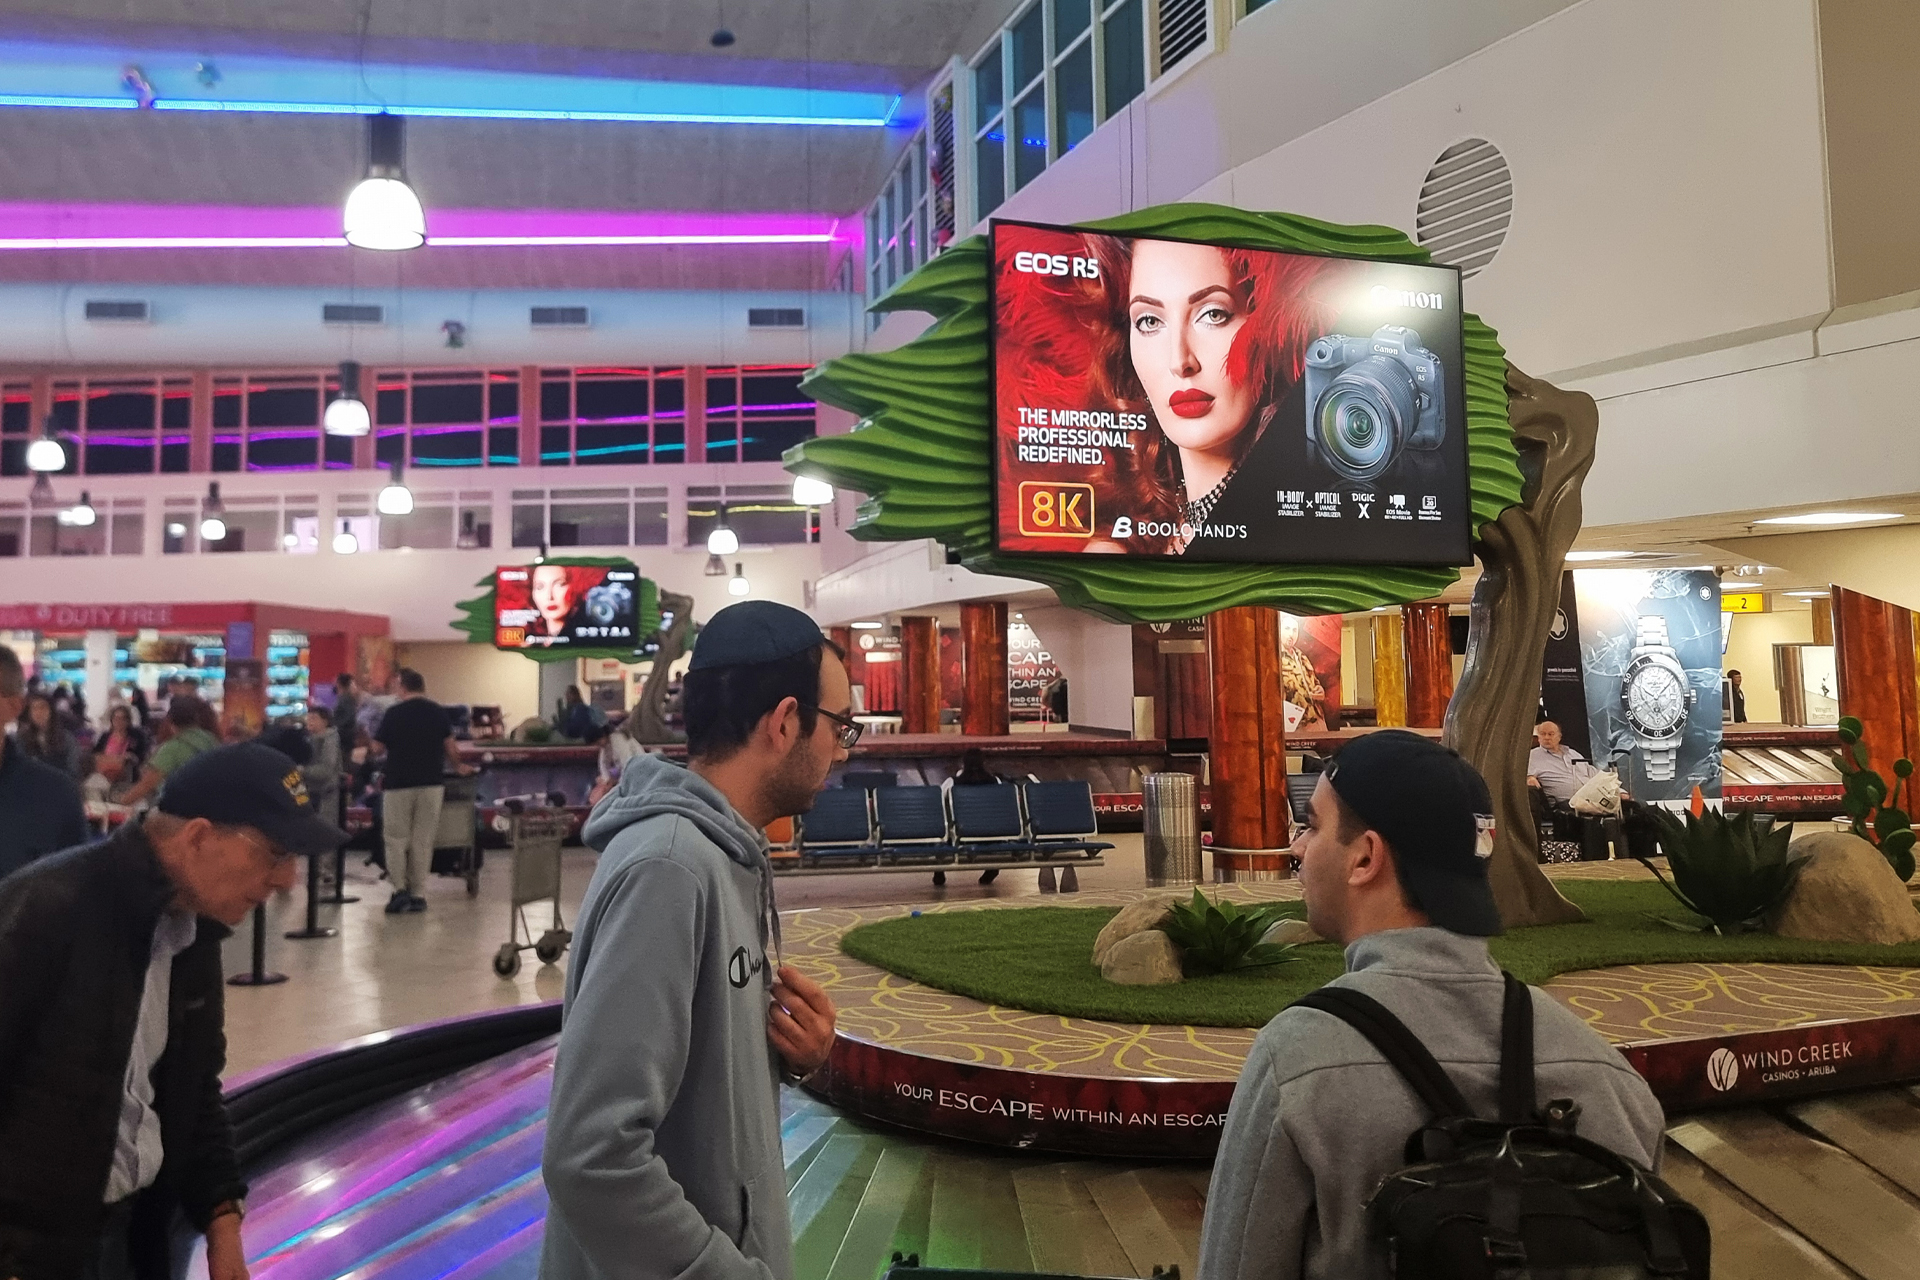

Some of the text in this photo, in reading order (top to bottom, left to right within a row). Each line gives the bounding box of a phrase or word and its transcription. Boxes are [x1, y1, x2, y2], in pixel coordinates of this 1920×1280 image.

[1015, 251, 1099, 279] EOS R5
[1370, 284, 1443, 310] Cnon
[1373, 344, 1399, 355] Canon
[1415, 365, 1427, 373] EOS
[1417, 374, 1426, 382] R5
[1018, 407, 1147, 431] THE MIRRORLESS
[1018, 426, 1135, 450] PROFESSIONAL,
[1018, 445, 1106, 466] REDEFINED.
[1276, 490, 1305, 504] IN-BODY
[1314, 491, 1342, 505] OPTICAL
[1351, 492, 1376, 503] DIGIC
[1032, 491, 1084, 528] 8K
[1358, 502, 1370, 519] X
[1741, 597, 1748, 610] 2
[57, 605, 172, 627] DUTY FREE
[1036, 667, 1057, 678] AN
[1731, 794, 1775, 803] ESCAPE
[1113, 803, 1144, 813] ESCA
[1742, 1040, 1853, 1071] WIND CREEK
[1761, 1064, 1837, 1083] CASINOS ARUBA
[893, 1081, 1229, 1127] YOUR ESCAPE WITHIN AN ESCAP
